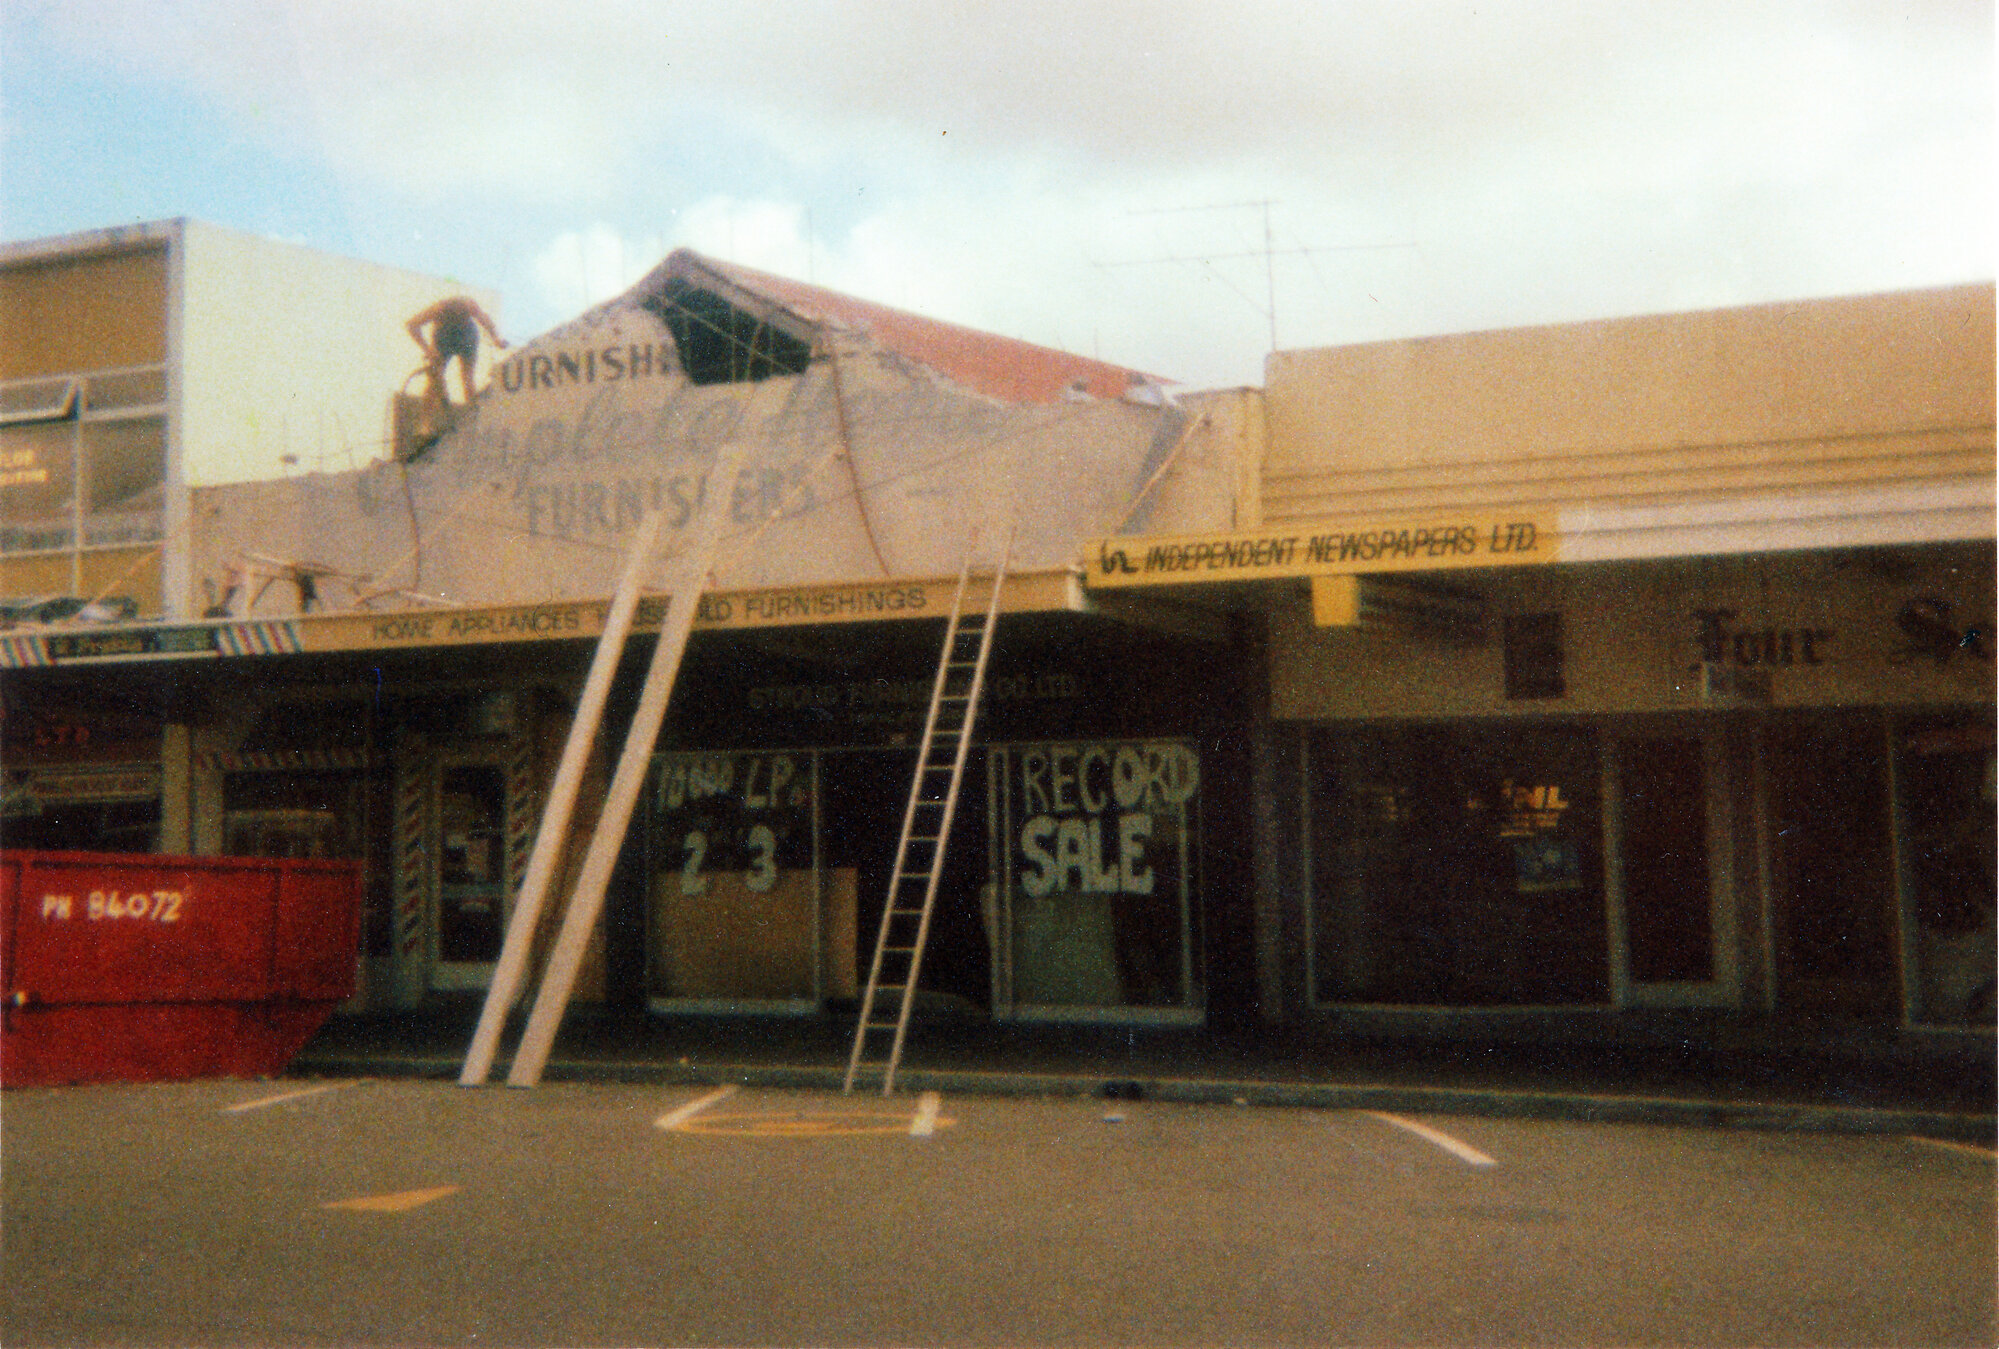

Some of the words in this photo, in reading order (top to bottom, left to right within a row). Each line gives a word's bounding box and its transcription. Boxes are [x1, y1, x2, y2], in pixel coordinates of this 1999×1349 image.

[1144, 537, 1298, 573] INDEPENDENT
[1306, 526, 1476, 563] NEWSPAPERS
[1489, 522, 1539, 552] LTD.
[372, 618, 433, 640] HOME
[448, 609, 579, 636] APPLIANCES
[745, 588, 926, 619] FURNISHINGS
[1023, 743, 1200, 814] RECORD
[746, 824, 777, 892] 3
[1021, 813, 1154, 898] SALE
